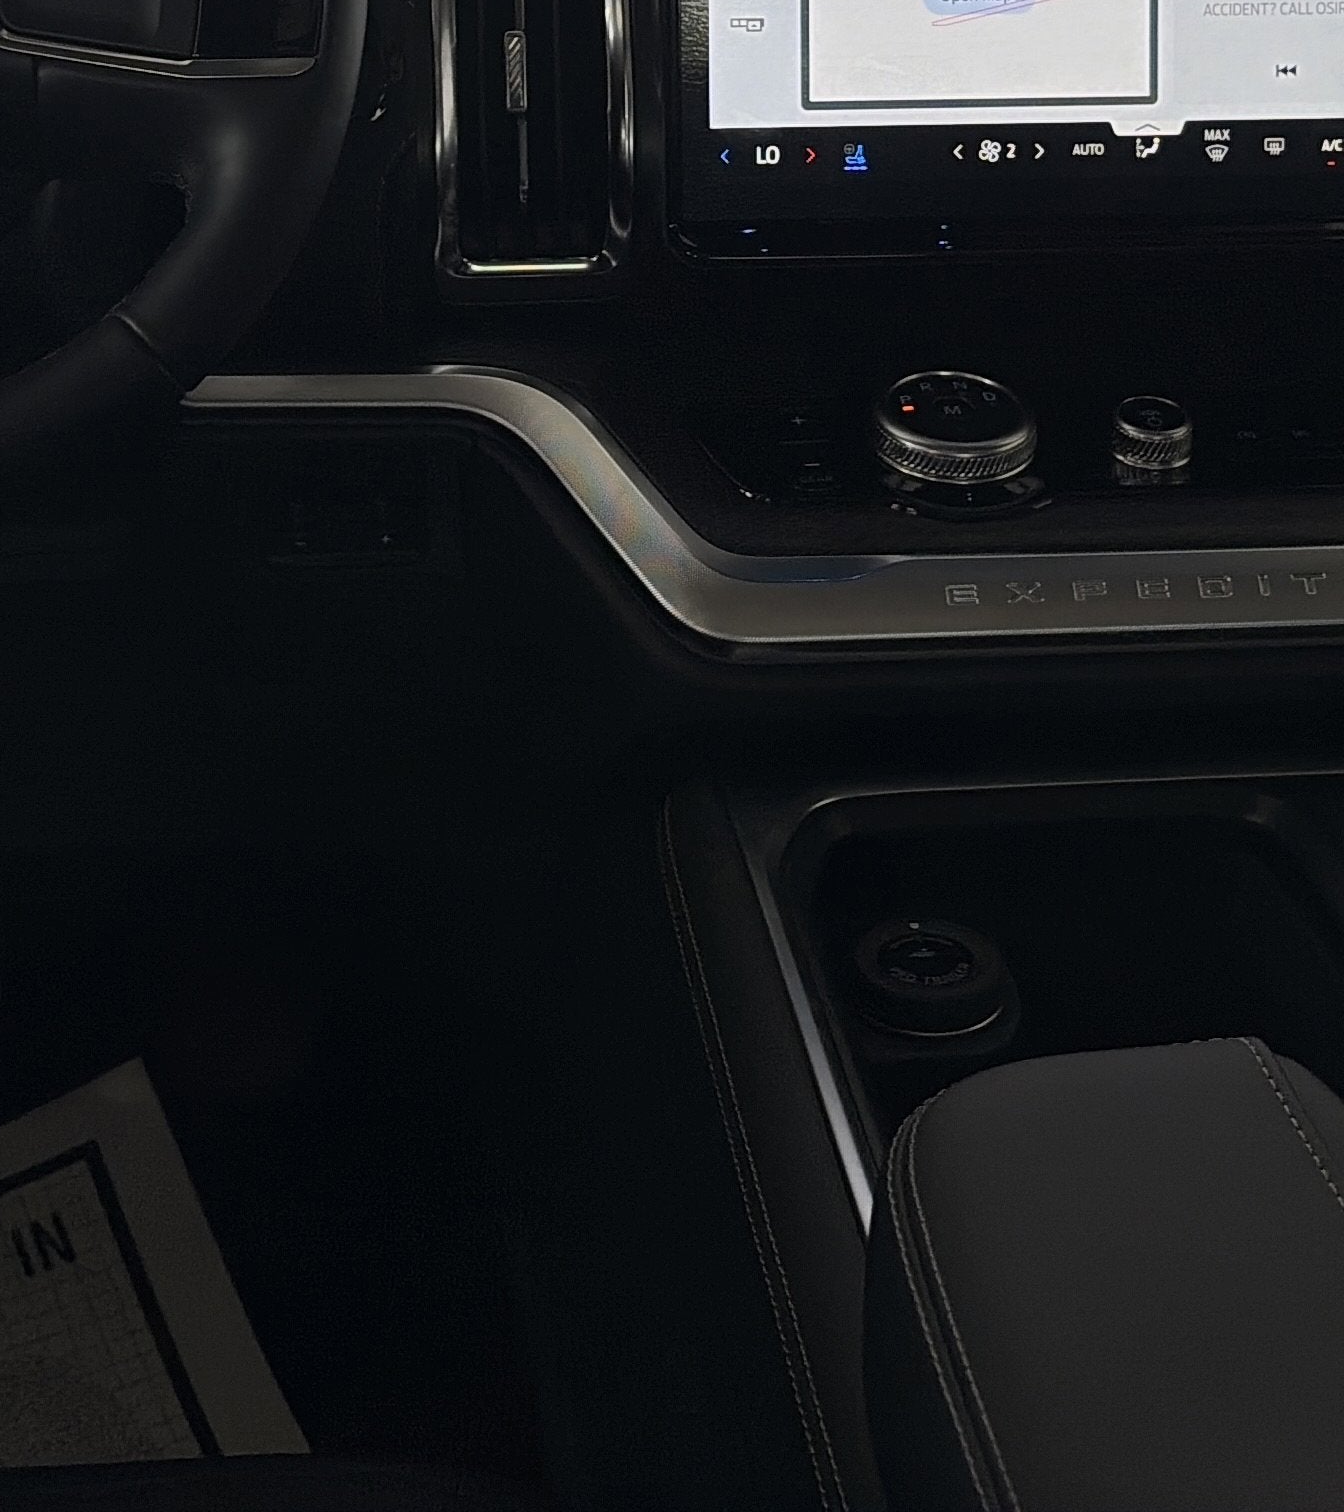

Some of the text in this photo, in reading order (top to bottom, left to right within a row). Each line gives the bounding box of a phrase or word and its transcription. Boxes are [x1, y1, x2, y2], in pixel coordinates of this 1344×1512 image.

[1203, 2, 1277, 17] ACCIDENT?
[1279, 2, 1314, 15] CALL
[1204, 128, 1231, 142] MAX
[1006, 142, 1016, 159] 2
[1072, 142, 1105, 157] AUTO
[1321, 138, 1343, 152] A/C
[756, 146, 781, 165] LO
[11, 1213, 76, 1277] IN
